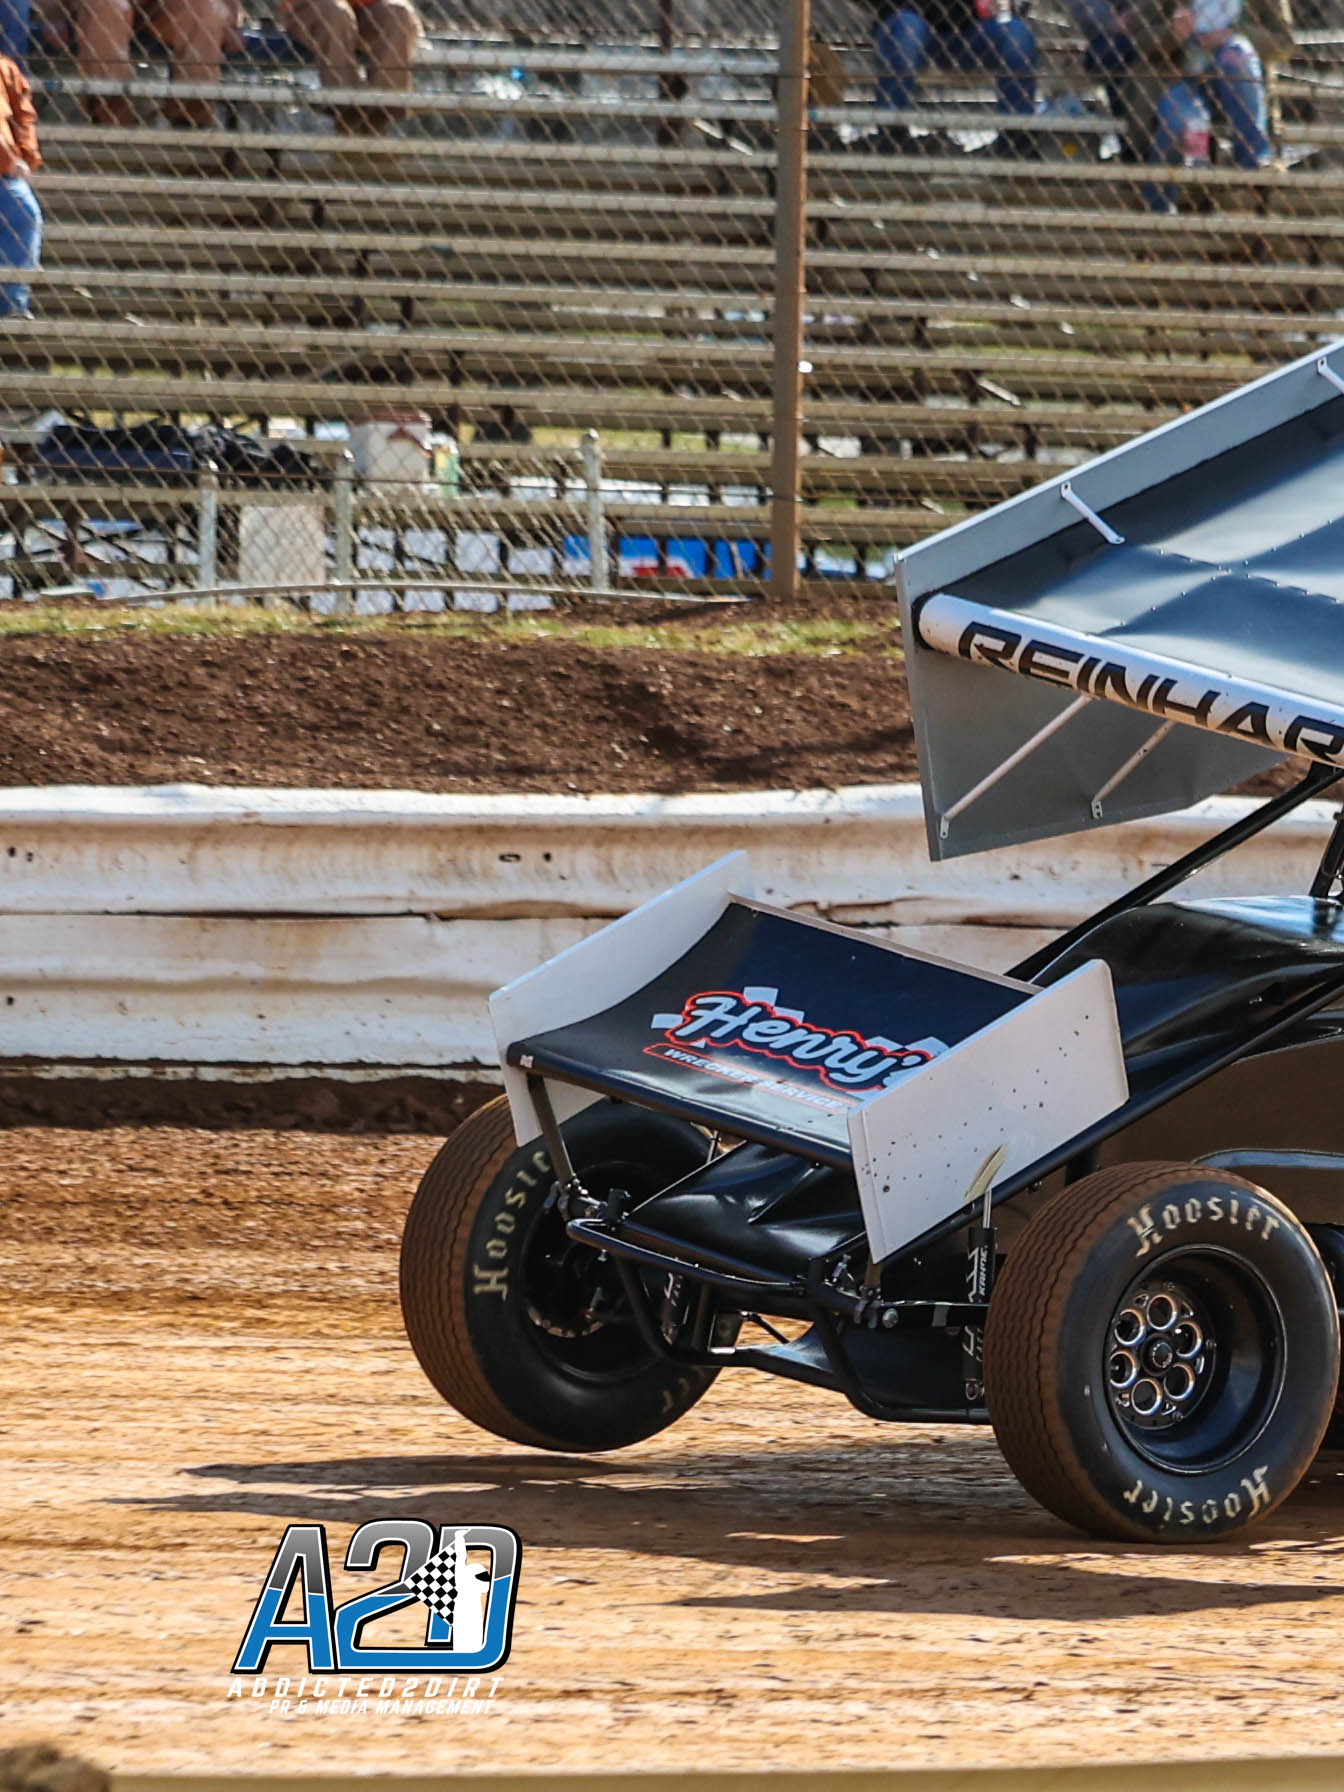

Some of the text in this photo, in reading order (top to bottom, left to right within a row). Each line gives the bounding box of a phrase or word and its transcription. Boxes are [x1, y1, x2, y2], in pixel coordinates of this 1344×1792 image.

[663, 1048, 844, 1109] WRECKER SERVICE
[1126, 1191, 1281, 1257] Hoosier
[1122, 1464, 1273, 1529] Hoosier
